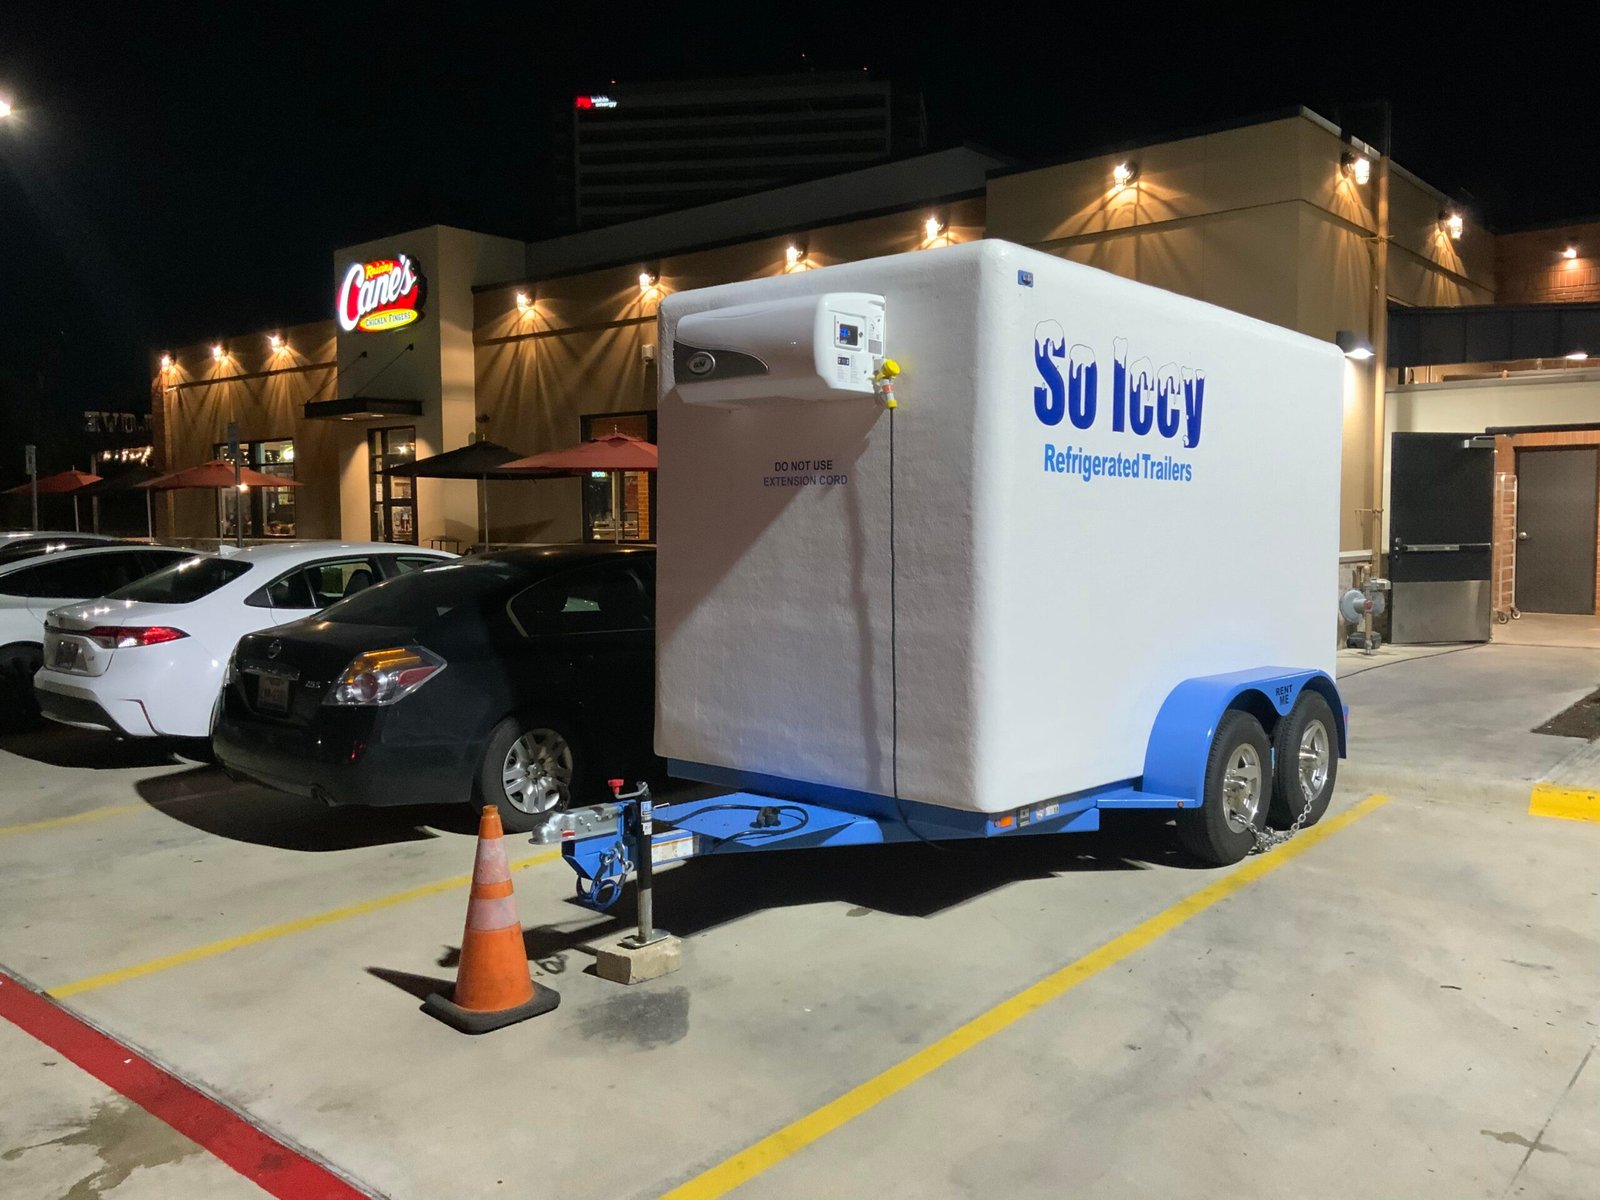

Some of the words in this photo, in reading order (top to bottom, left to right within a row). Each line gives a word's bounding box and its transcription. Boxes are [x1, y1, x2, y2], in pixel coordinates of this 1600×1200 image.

[365, 261, 393, 280] Raising
[339, 253, 417, 331] Cane's
[365, 316, 387, 327] CHICKEN
[388, 311, 412, 322] FINGERS
[1034, 319, 1098, 430] So
[774, 461, 789, 472] DO
[790, 460, 811, 471] NOT
[813, 459, 833, 470] USE
[1044, 443, 1140, 483] Refrigerated
[1141, 454, 1192, 482] Trailers
[763, 475, 817, 487] EXTENSION
[819, 474, 848, 485] CORD
[1275, 684, 1293, 696] RENT
[1279, 694, 1289, 705] ME
